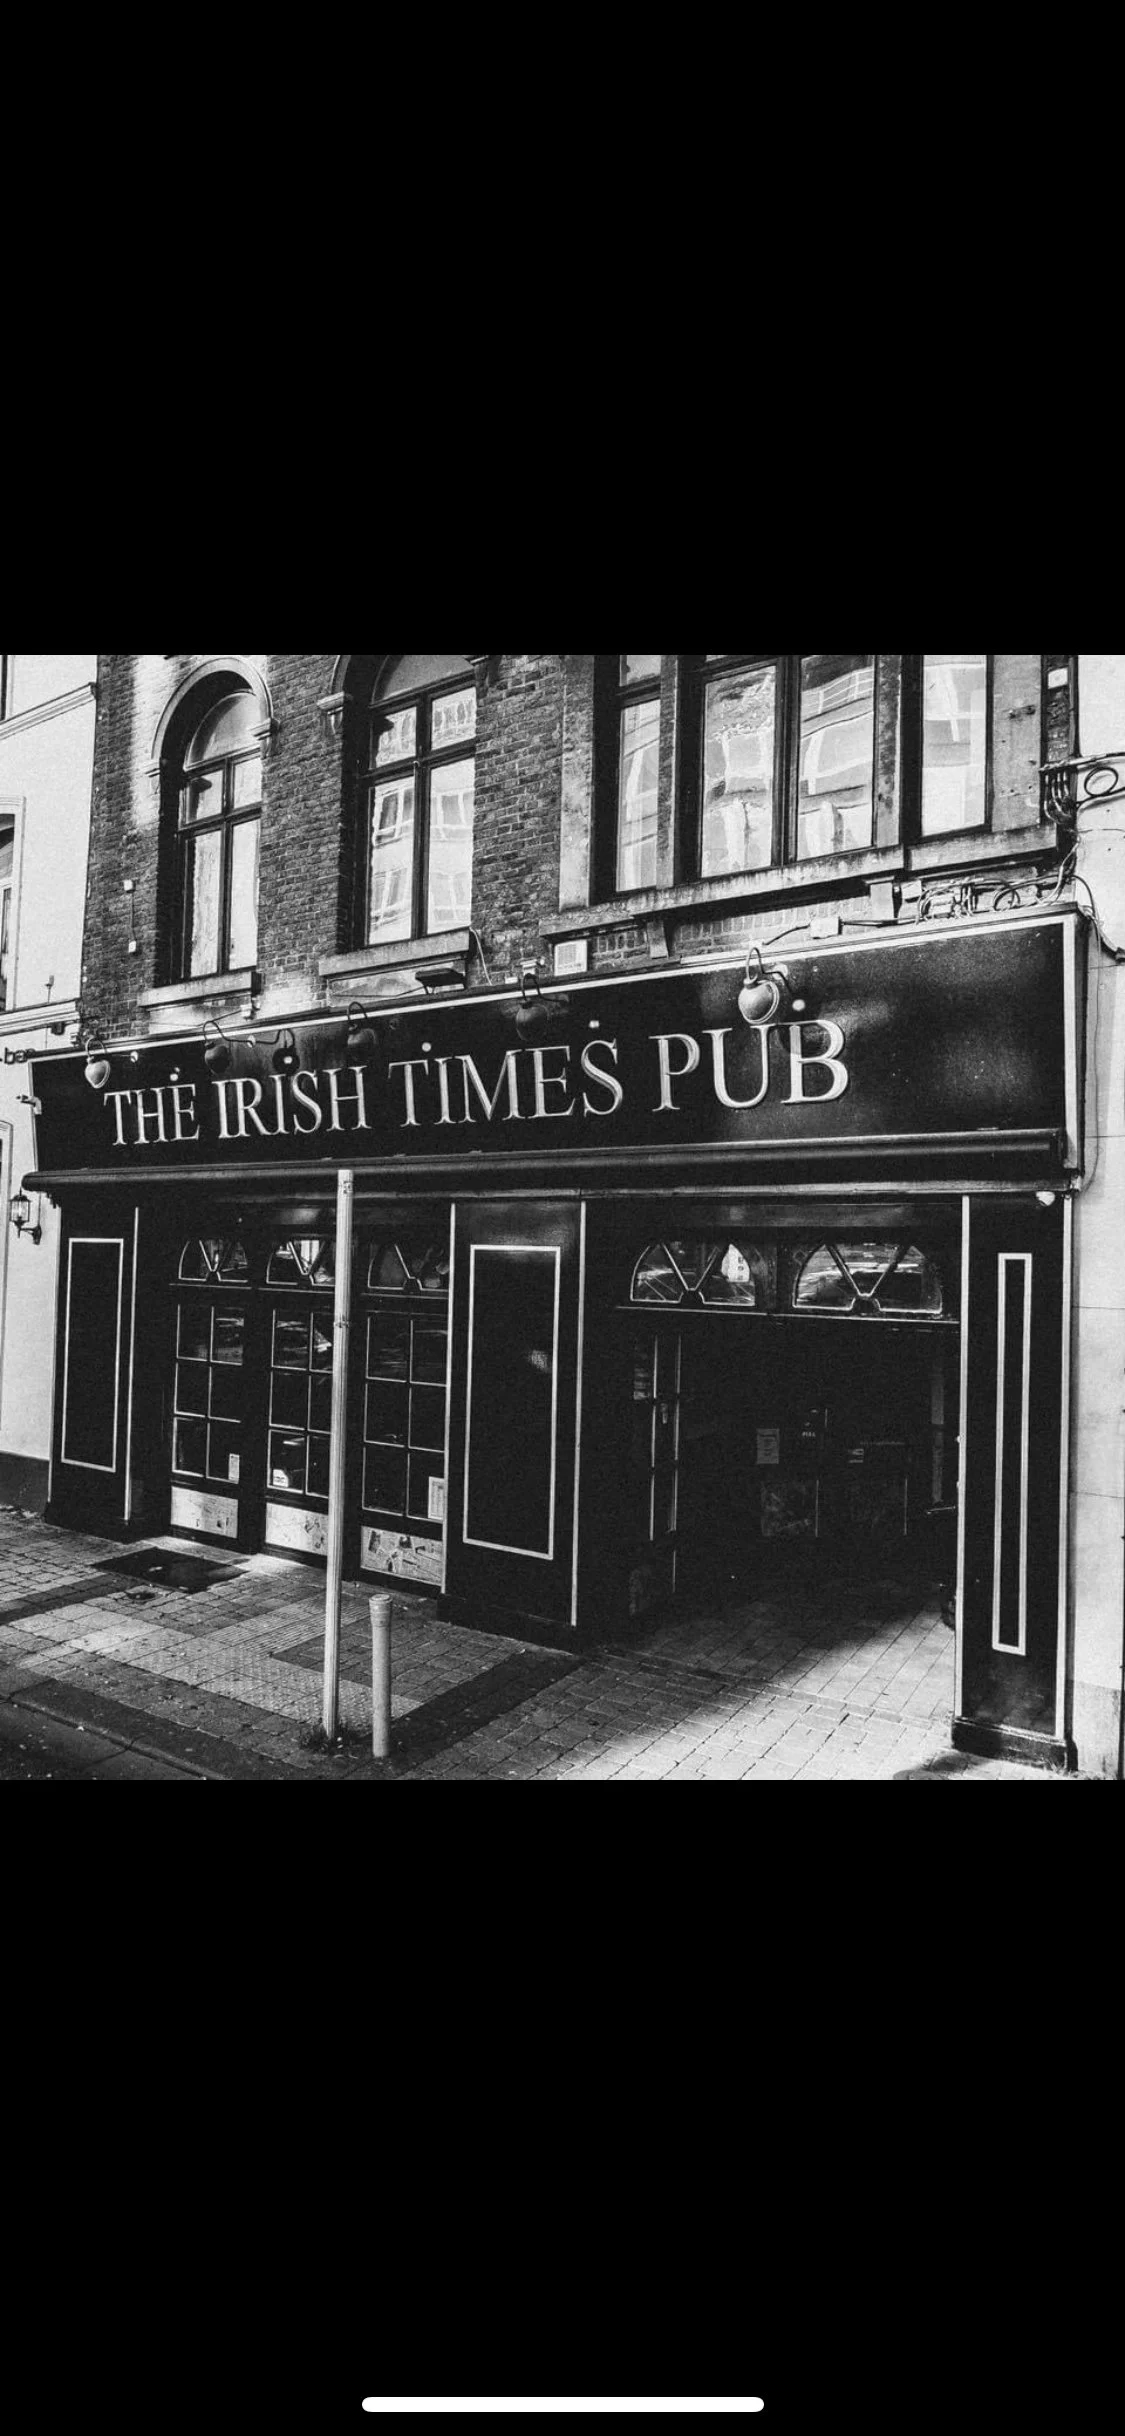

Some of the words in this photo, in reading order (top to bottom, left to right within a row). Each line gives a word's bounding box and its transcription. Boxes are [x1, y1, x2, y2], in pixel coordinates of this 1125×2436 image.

[103, 1083, 200, 1146] THE
[211, 1064, 372, 1139] IRISH
[388, 1038, 624, 1128] TIMES
[649, 1018, 850, 1112] PUB
